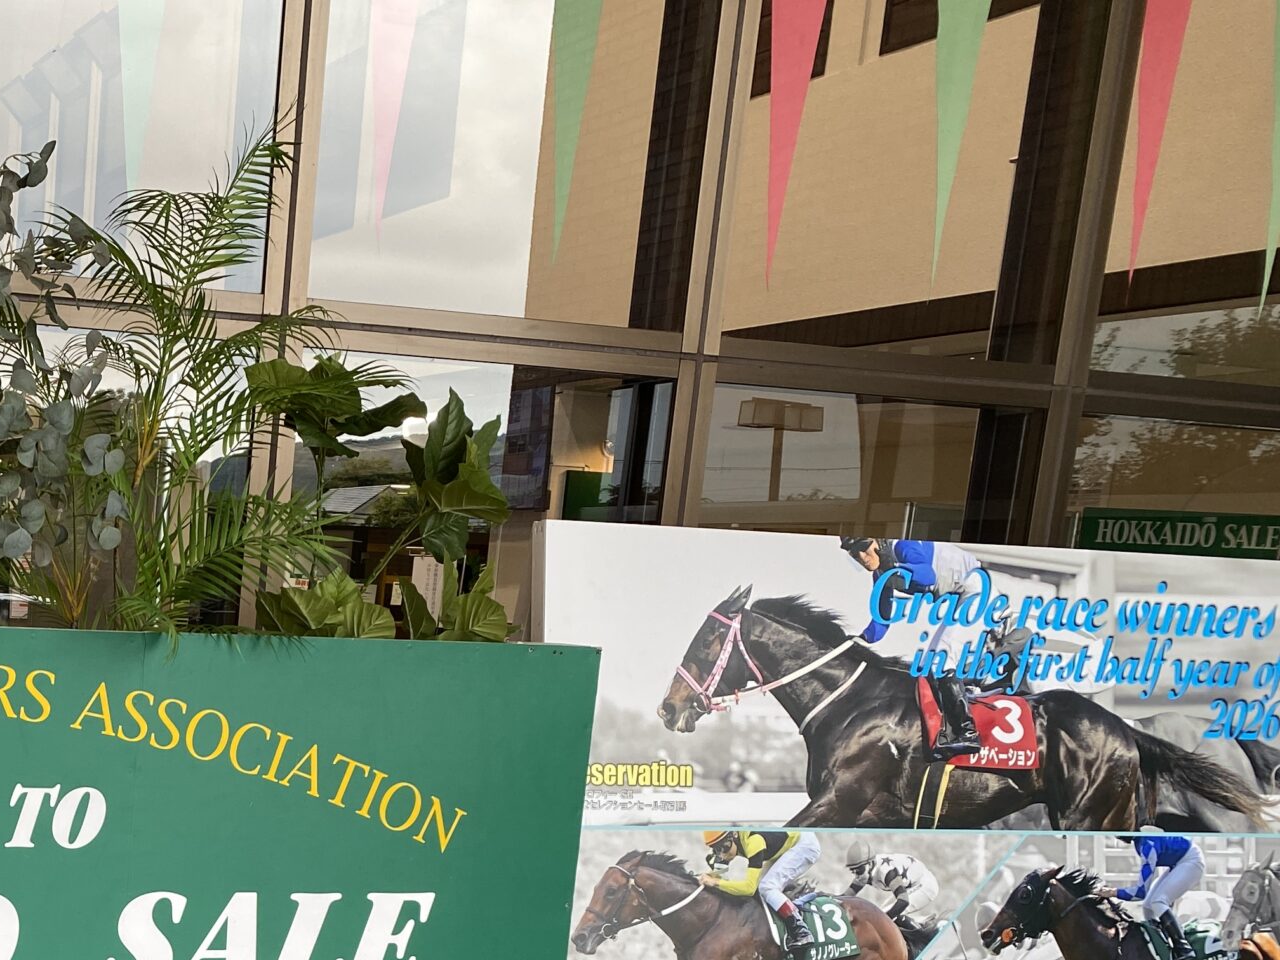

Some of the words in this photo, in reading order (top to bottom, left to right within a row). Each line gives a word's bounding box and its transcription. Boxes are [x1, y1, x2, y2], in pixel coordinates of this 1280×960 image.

[1221, 523, 1280, 550] SALE
[869, 567, 1007, 627] Grade
[1017, 593, 1108, 633] race
[1117, 581, 1278, 640] winners
[909, 632, 946, 680] in
[956, 639, 1008, 684] the
[1006, 634, 1093, 696] first
[1096, 636, 1172, 700] half
[1166, 657, 1250, 701] year
[991, 699, 1024, 744] 3
[1202, 698, 1280, 742] 2026
[70, 681, 468, 854] ASSOCIATION
[969, 746, 1035, 767] レザベーション
[4, 783, 107, 849] TO
[808, 902, 849, 943] 13
